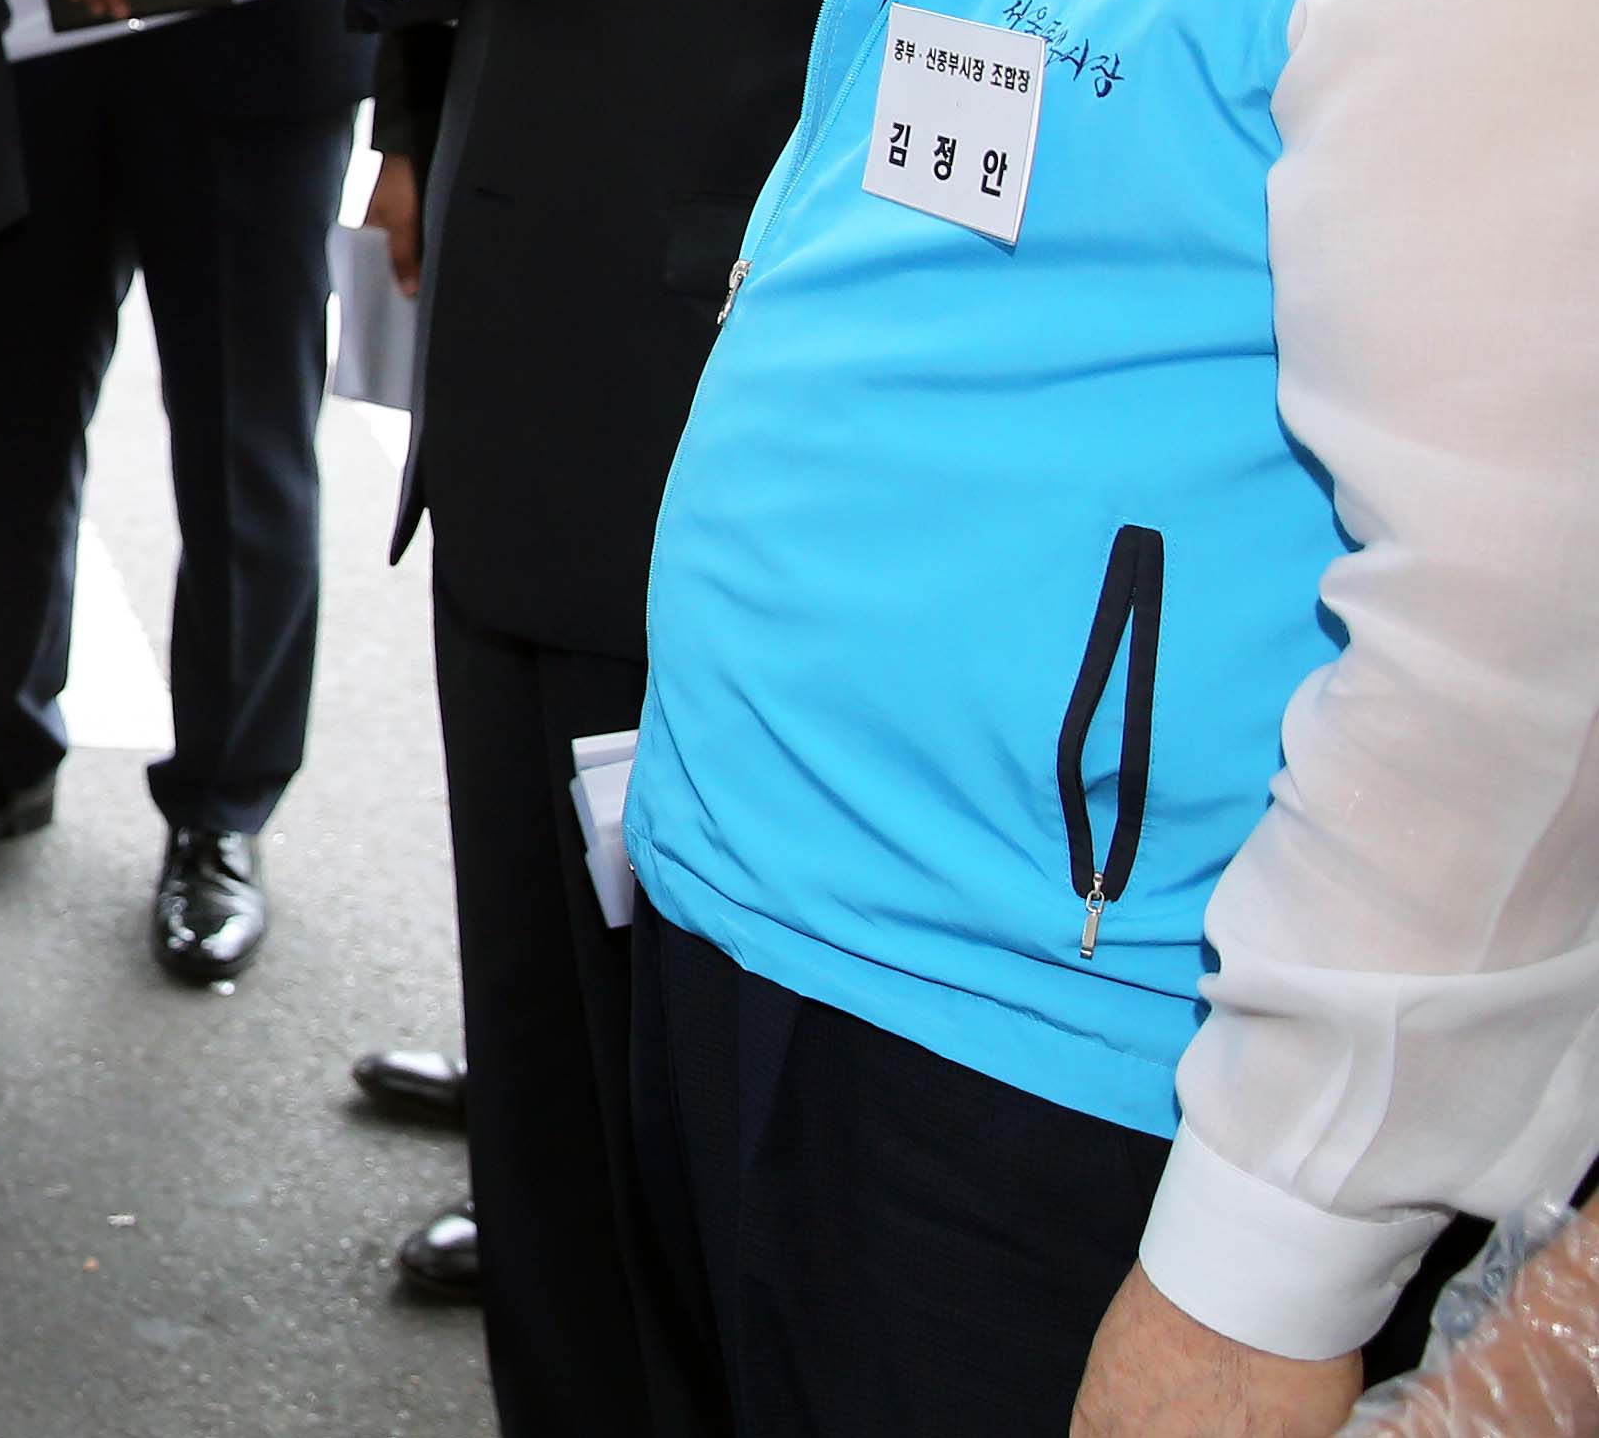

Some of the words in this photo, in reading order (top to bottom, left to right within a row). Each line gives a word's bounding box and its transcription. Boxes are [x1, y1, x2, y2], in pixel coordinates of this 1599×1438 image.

[894, 38, 916, 64] 중부
[926, 47, 985, 82] 신중부시장
[990, 62, 1031, 93] 조합장
